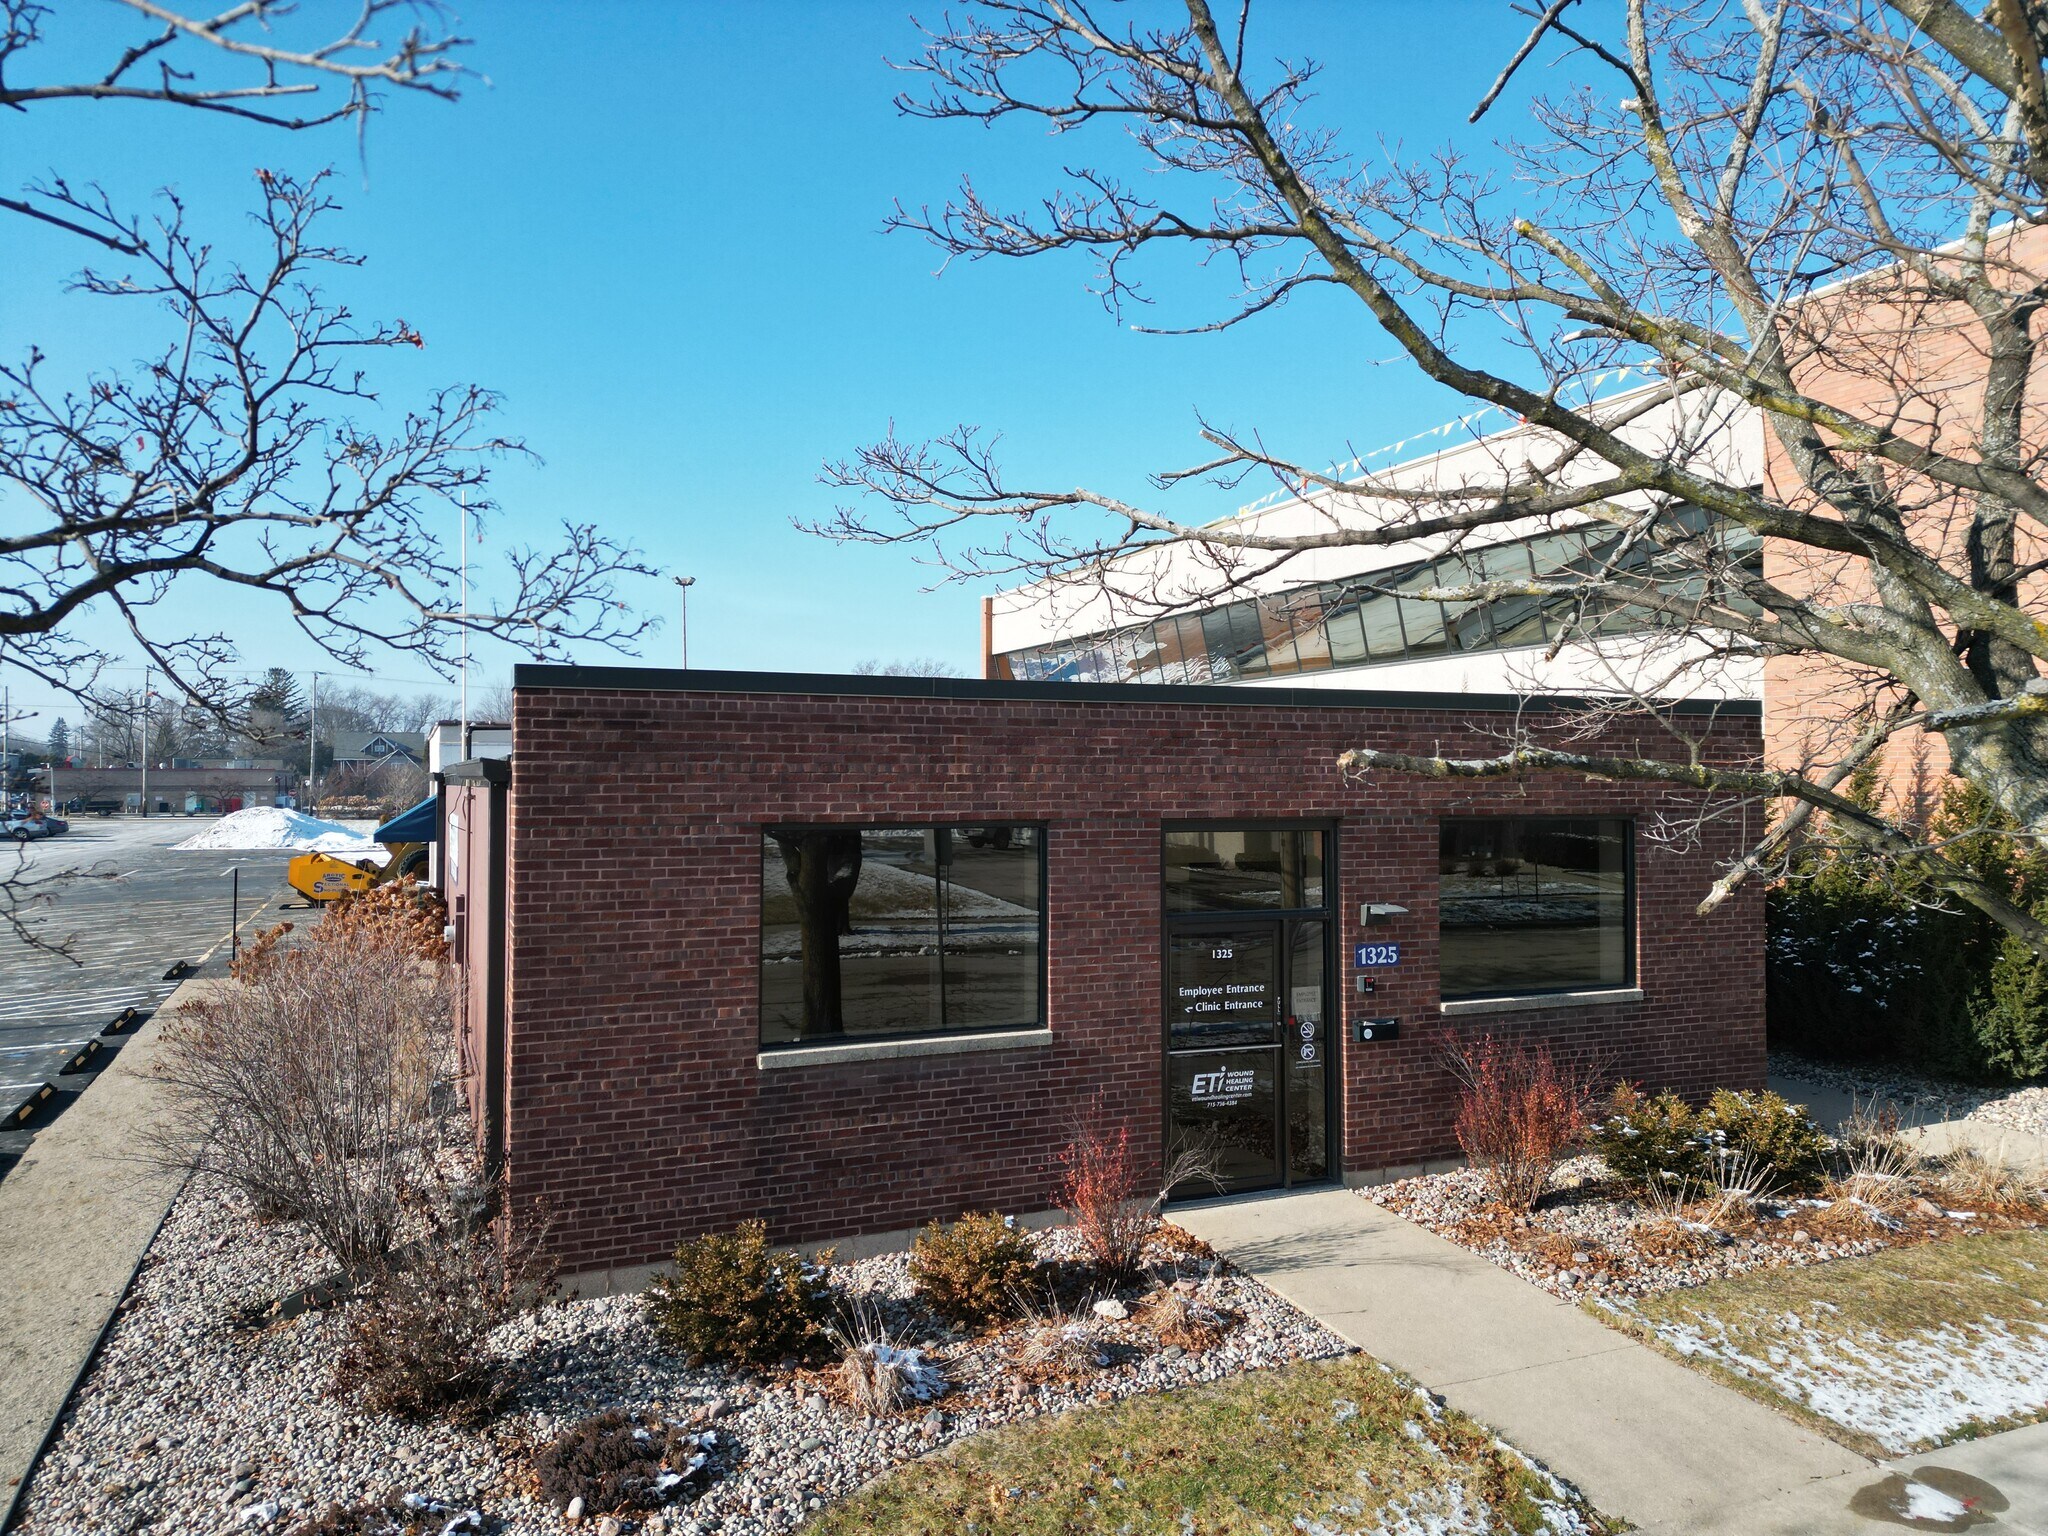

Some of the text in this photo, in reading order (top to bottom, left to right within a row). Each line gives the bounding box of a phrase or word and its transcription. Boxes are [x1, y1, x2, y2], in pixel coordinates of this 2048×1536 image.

[1212, 949, 1233, 959] 1325
[1357, 946, 1398, 965] 1325
[1179, 984, 1265, 998] Employee Entrance
[1195, 1000, 1263, 1012] Clinic Entrance
[1227, 1070, 1254, 1078] WOUND
[1225, 1077, 1253, 1085] HEALING
[1225, 1084, 1253, 1092] CENTER
